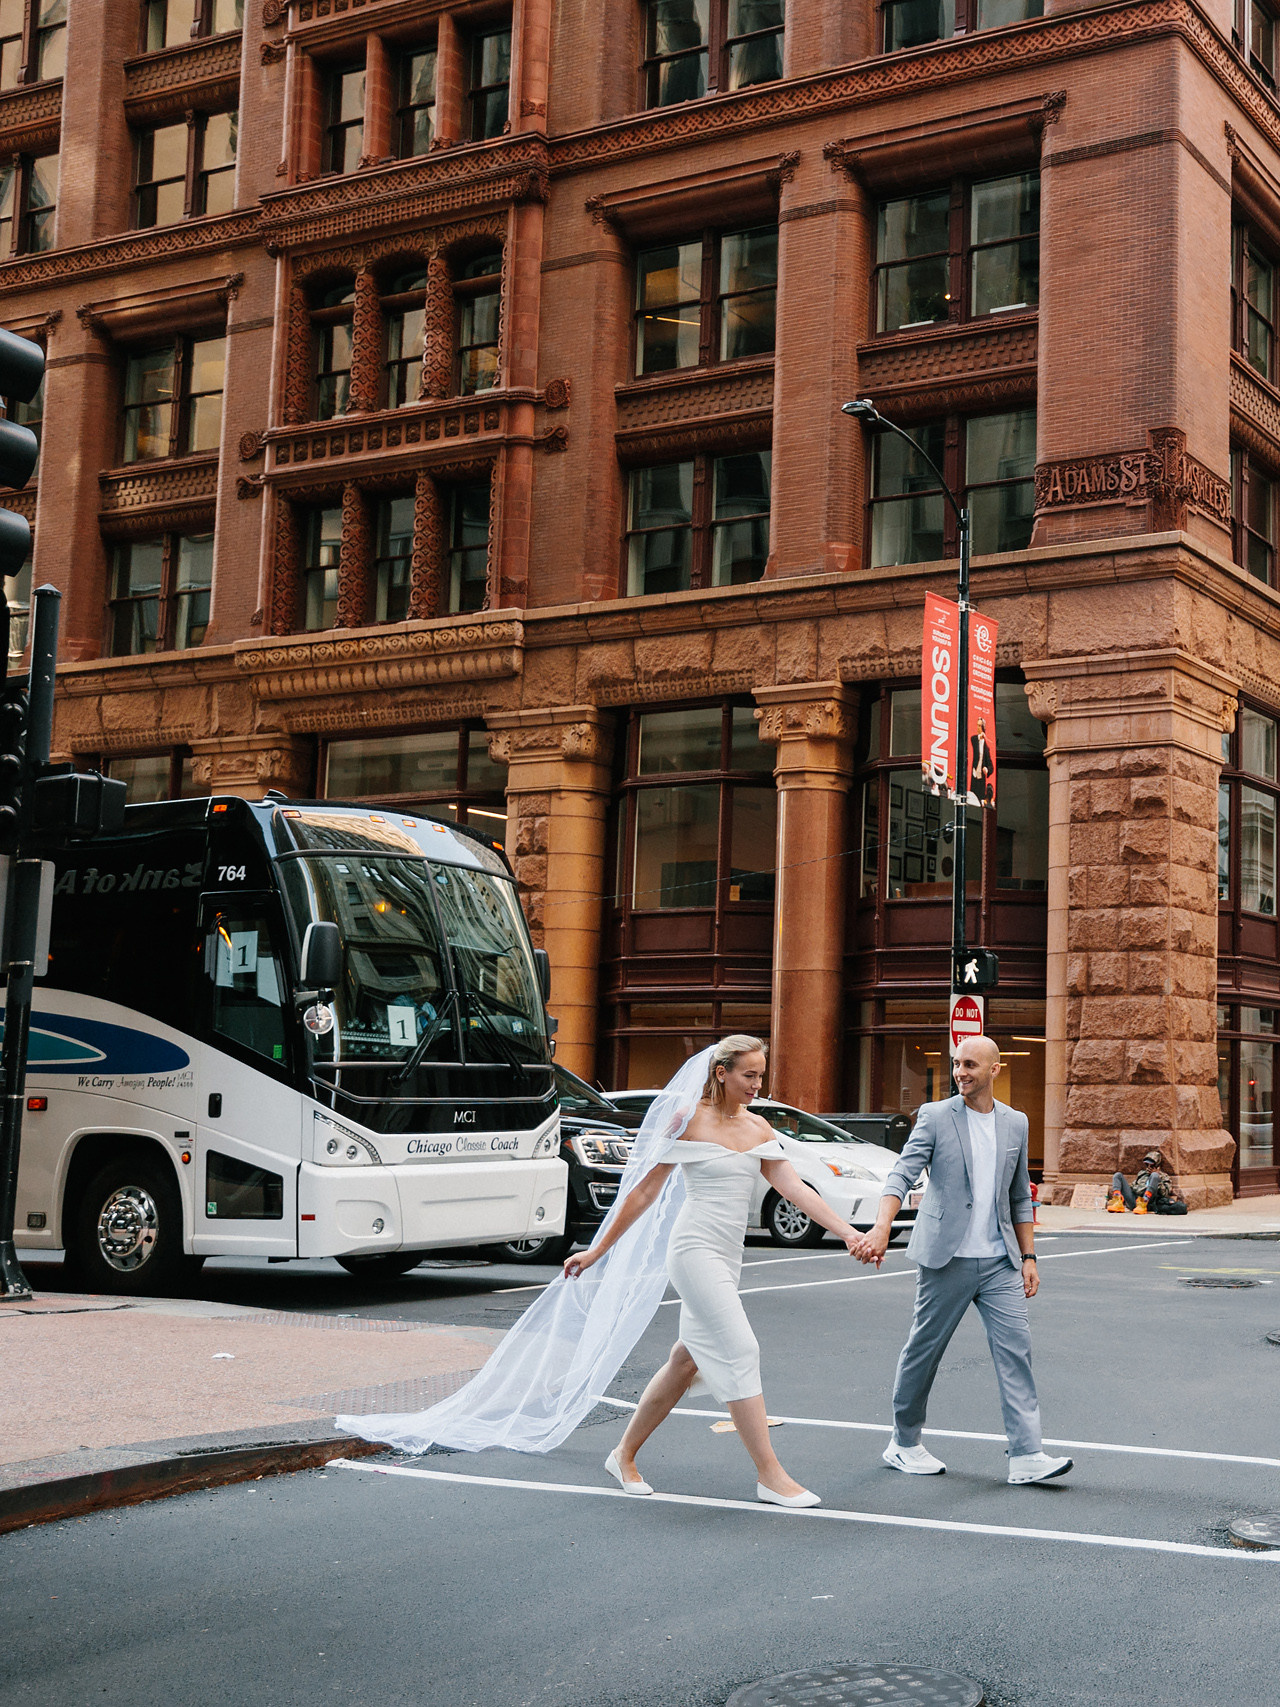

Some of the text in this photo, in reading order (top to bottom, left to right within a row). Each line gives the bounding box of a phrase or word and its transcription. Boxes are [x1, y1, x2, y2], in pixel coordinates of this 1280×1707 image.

[1049, 464, 1120, 502] ADAMS
[972, 654, 992, 667] CHICAGO
[930, 646, 950, 785] SOUND
[217, 865, 246, 882] 764
[238, 945, 249, 967] 1
[955, 1007, 978, 1018] DO NOT
[396, 1019, 409, 1040] 1
[77, 1077, 89, 1087] We
[91, 1077, 115, 1089] Carry
[146, 1076, 176, 1090] People!
[453, 1110, 477, 1124] MCI
[407, 1136, 519, 1156] Chicago Classic Coach
